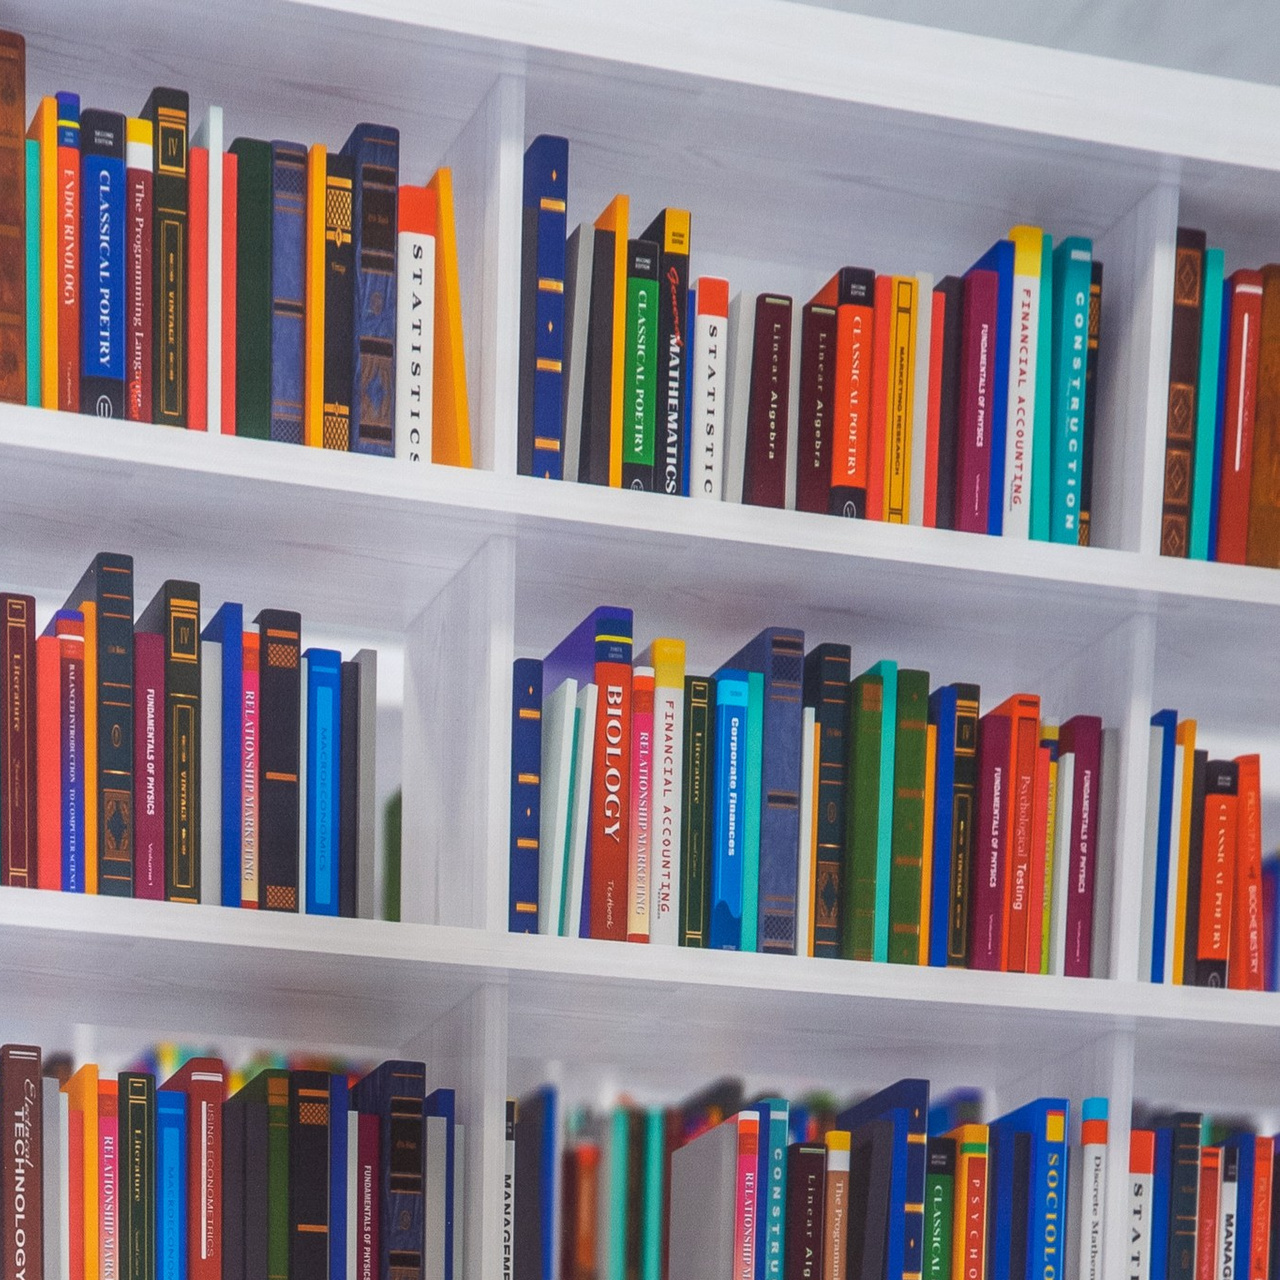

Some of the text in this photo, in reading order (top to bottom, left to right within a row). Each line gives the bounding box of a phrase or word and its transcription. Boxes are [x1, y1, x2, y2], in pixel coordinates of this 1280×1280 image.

[135, 181, 145, 212] The
[168, 138, 177, 157] IV
[64, 169, 75, 306] ENDOCRINOLOGY
[99, 169, 111, 369] CLASSICAL POETRY
[133, 217, 145, 327] Programming
[167, 290, 175, 345] VINTAGE
[633, 289, 648, 456] CLASSICAL POETRY
[1017, 288, 1031, 387] FINANCIAL
[665, 334, 681, 494] MATHEMATICS
[768, 323, 781, 460] Linear Algebra
[814, 332, 827, 468] Linear Algebra
[847, 315, 862, 476] CLASSICAL POETRY
[894, 346, 905, 476] MARKETING RESEARCH
[1012, 396, 1025, 505] ACCOUNTING
[1065, 291, 1085, 530] CONSTRUCTION
[13, 654, 21, 732] Literature
[146, 688, 155, 816] FUNDAMENTALS OF PHYSICS
[243, 690, 255, 882] RELATIONSHIP MARKETING
[603, 685, 623, 844] BIOLOGY
[635, 731, 649, 916] RELATIONSHIP MARKETING
[660, 700, 675, 913] FINANCIAL ACCOUNTING
[694, 731, 703, 805] Literature
[727, 716, 741, 857] Corporate Finances
[1013, 775, 1031, 911] Psychological Testing
[103, 1136, 114, 1236] RELATIONSHIP
[133, 1128, 142, 1203] Literature
[205, 1103, 214, 1258] USING ECONOMETRICS
[363, 1165, 372, 1232] FUNDAMENTALS
[743, 1172, 754, 1266] RELATIONSHIP
[805, 1174, 816, 1238] Linear
[835, 1180, 844, 1207] The
[1092, 1155, 1102, 1217] Discrete
[363, 1233, 371, 1245] OF
[932, 1184, 943, 1274] CLASSICAL
